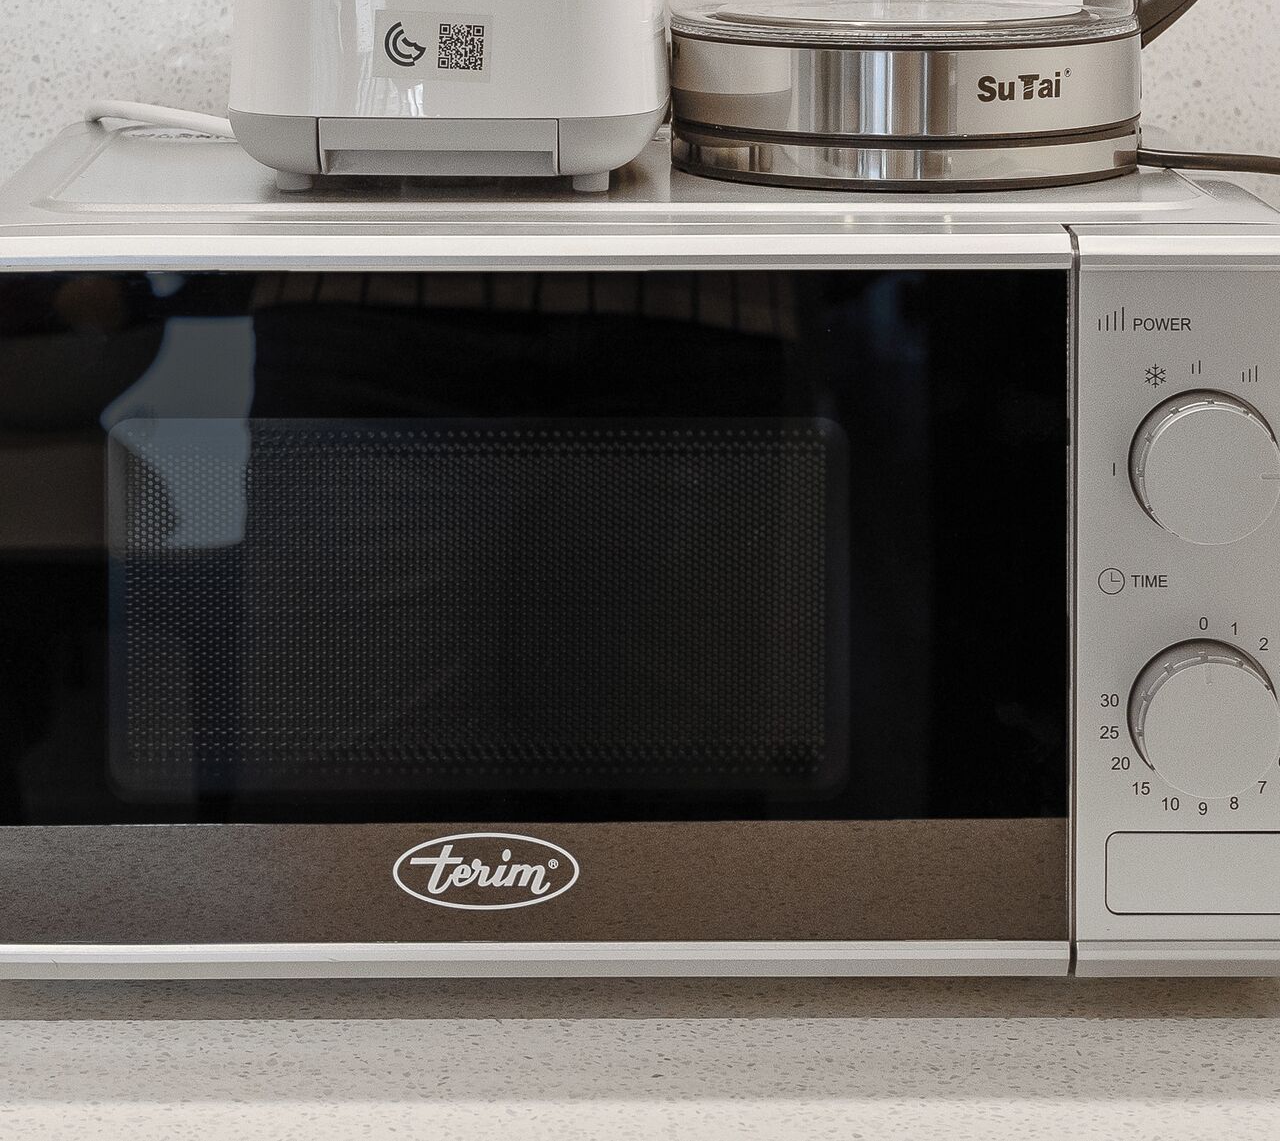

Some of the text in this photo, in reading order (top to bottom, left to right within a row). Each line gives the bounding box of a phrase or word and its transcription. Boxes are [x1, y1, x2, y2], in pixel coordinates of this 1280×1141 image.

[1133, 317, 1192, 332] POWER
[1131, 574, 1168, 588] TIME
[1198, 616, 1209, 631] 0
[1230, 622, 1238, 635] 1
[1258, 637, 1269, 651] 2
[1100, 694, 1120, 708] 30
[1099, 726, 1120, 740] 25
[1111, 757, 1131, 771] 20
[1132, 782, 1151, 796] 15
[1257, 780, 1268, 794] 7
[1161, 797, 1180, 811] 10
[1198, 802, 1209, 816] 9
[1229, 797, 1240, 811] 8
